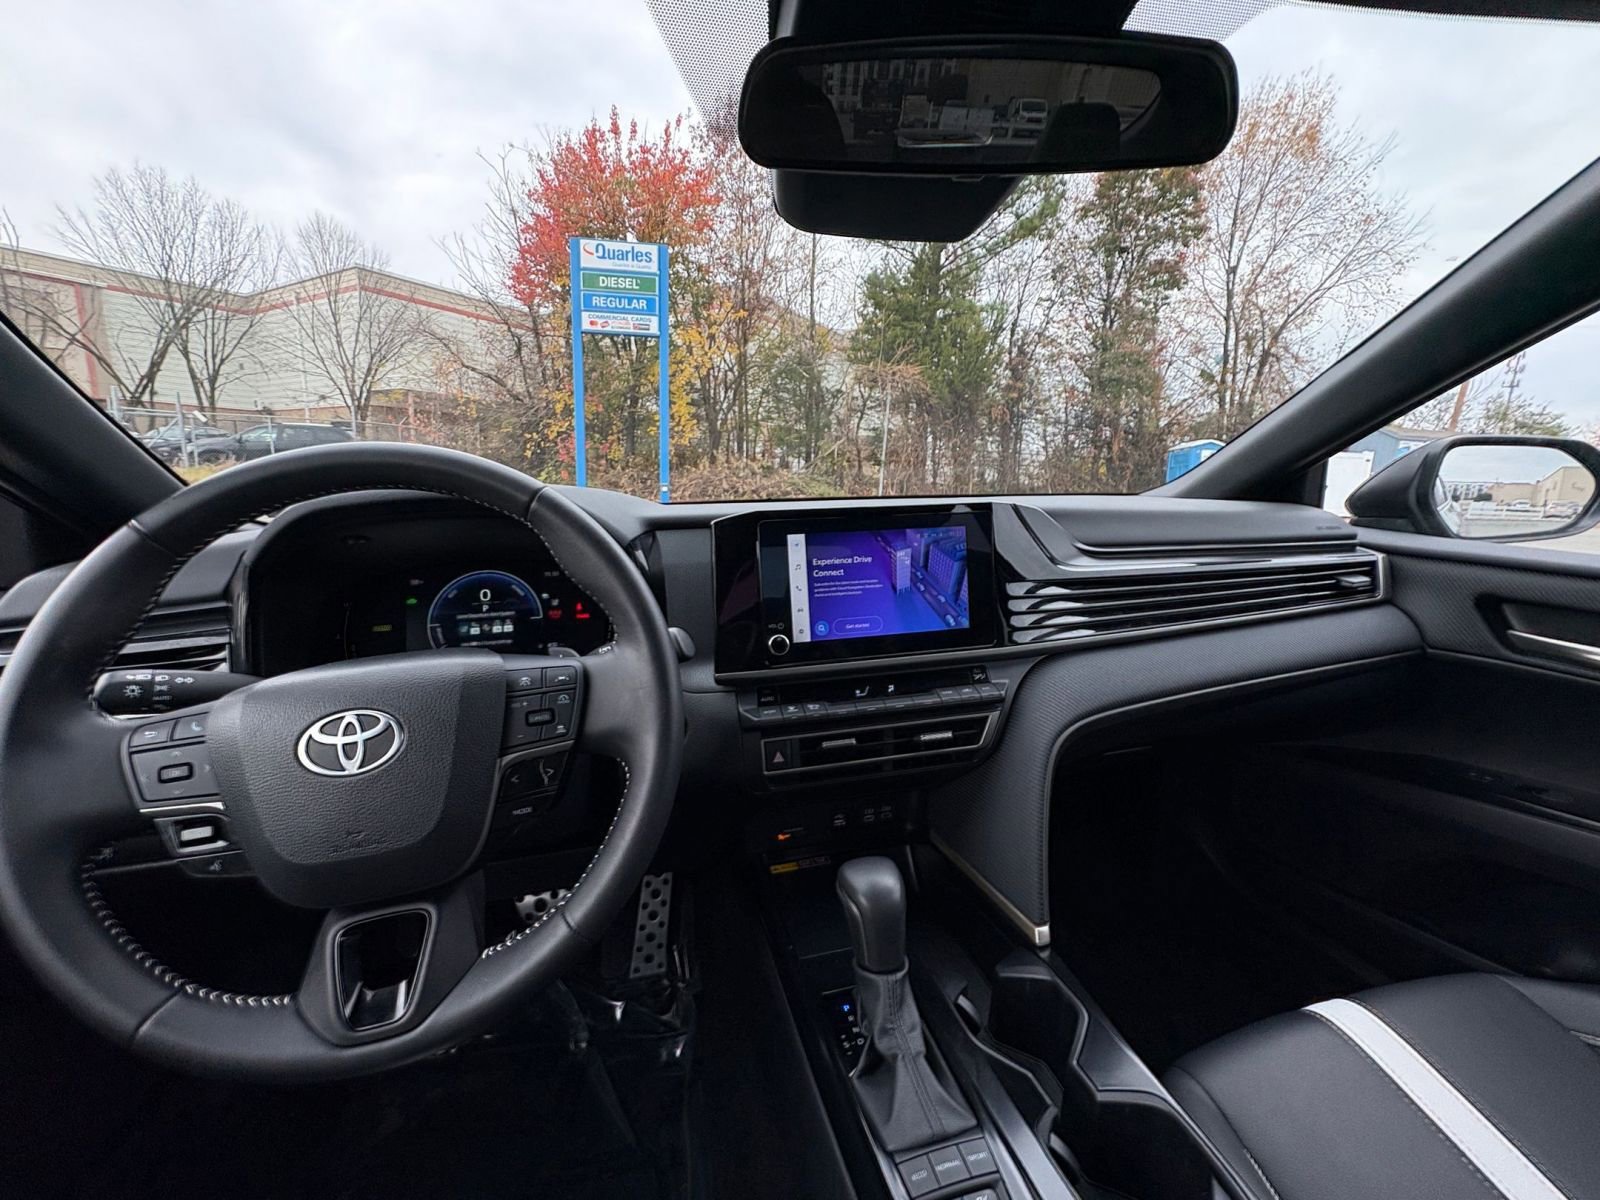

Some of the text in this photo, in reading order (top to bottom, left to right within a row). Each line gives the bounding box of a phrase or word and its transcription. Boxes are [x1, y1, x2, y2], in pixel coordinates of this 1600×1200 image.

[595, 243, 653, 263] Quarles
[599, 276, 640, 289] DIESEL
[592, 296, 647, 310] REGULAR
[588, 313, 629, 322] COMMERCIAL
[812, 555, 873, 567] Experience Drive
[813, 569, 844, 577] Connect
